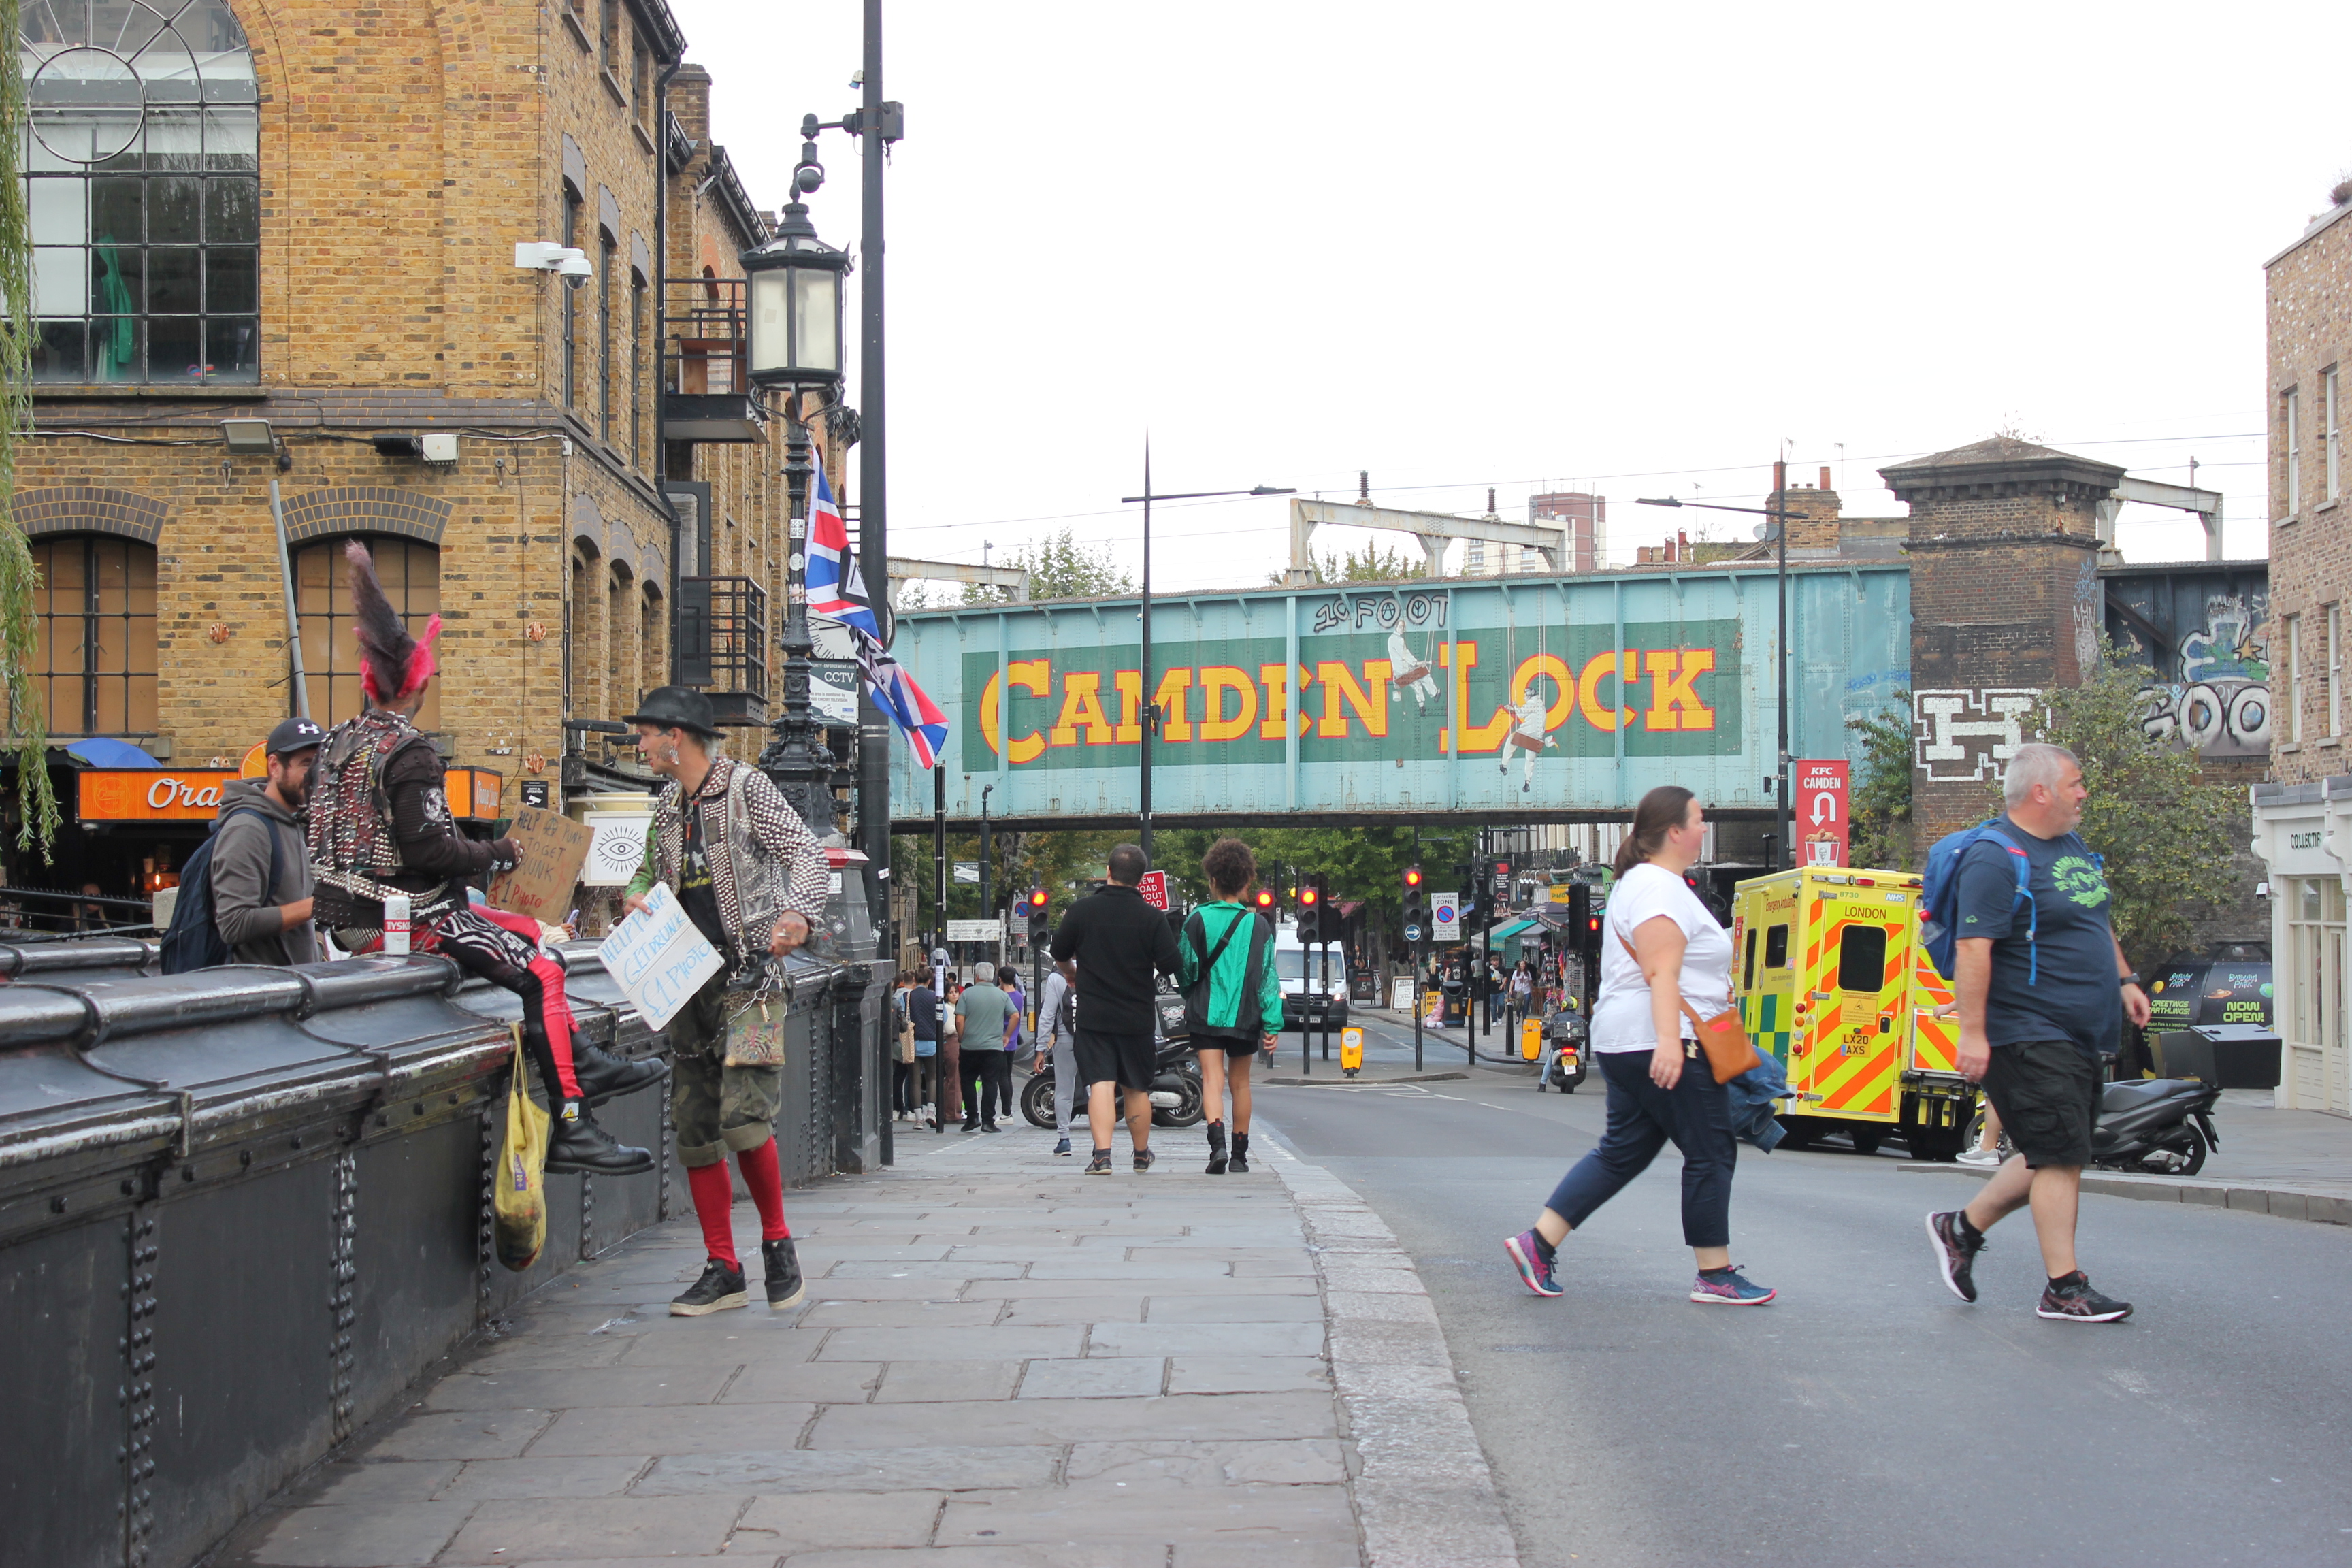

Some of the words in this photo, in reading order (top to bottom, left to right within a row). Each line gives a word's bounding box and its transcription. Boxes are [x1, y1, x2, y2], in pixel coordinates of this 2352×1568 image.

[824, 671, 855, 683] CCTV
[979, 657, 1393, 764] CAMDEN
[1439, 640, 1715, 754] LOCK
[1810, 767, 1833, 775] KFC
[1803, 777, 1841, 789] CAMDEN
[518, 811, 541, 832] HELP
[562, 823, 584, 846] PUNK
[519, 852, 555, 883] RUNK
[1140, 877, 1154, 885] EW
[1137, 884, 1158, 893] OAD
[510, 884, 543, 909] PHOTO
[1840, 891, 1859, 899] 8730
[1886, 893, 1904, 902] NHS
[1766, 898, 1780, 913] Emergency
[1781, 894, 1795, 909] Ambulance
[1844, 906, 1886, 919] LONDON
[601, 921, 633, 964] HELP
[624, 942, 651, 985] GET
[649, 909, 688, 954] DRUNK
[665, 941, 712, 990] PHOTO
[2228, 973, 2257, 982] BABYLON
[2234, 981, 2253, 989] PARK
[2226, 1001, 2260, 1011] NOW
[2223, 1012, 2265, 1022] OPEN!
[1844, 1034, 1869, 1045] LX20
[1846, 1045, 1865, 1055] AXS
